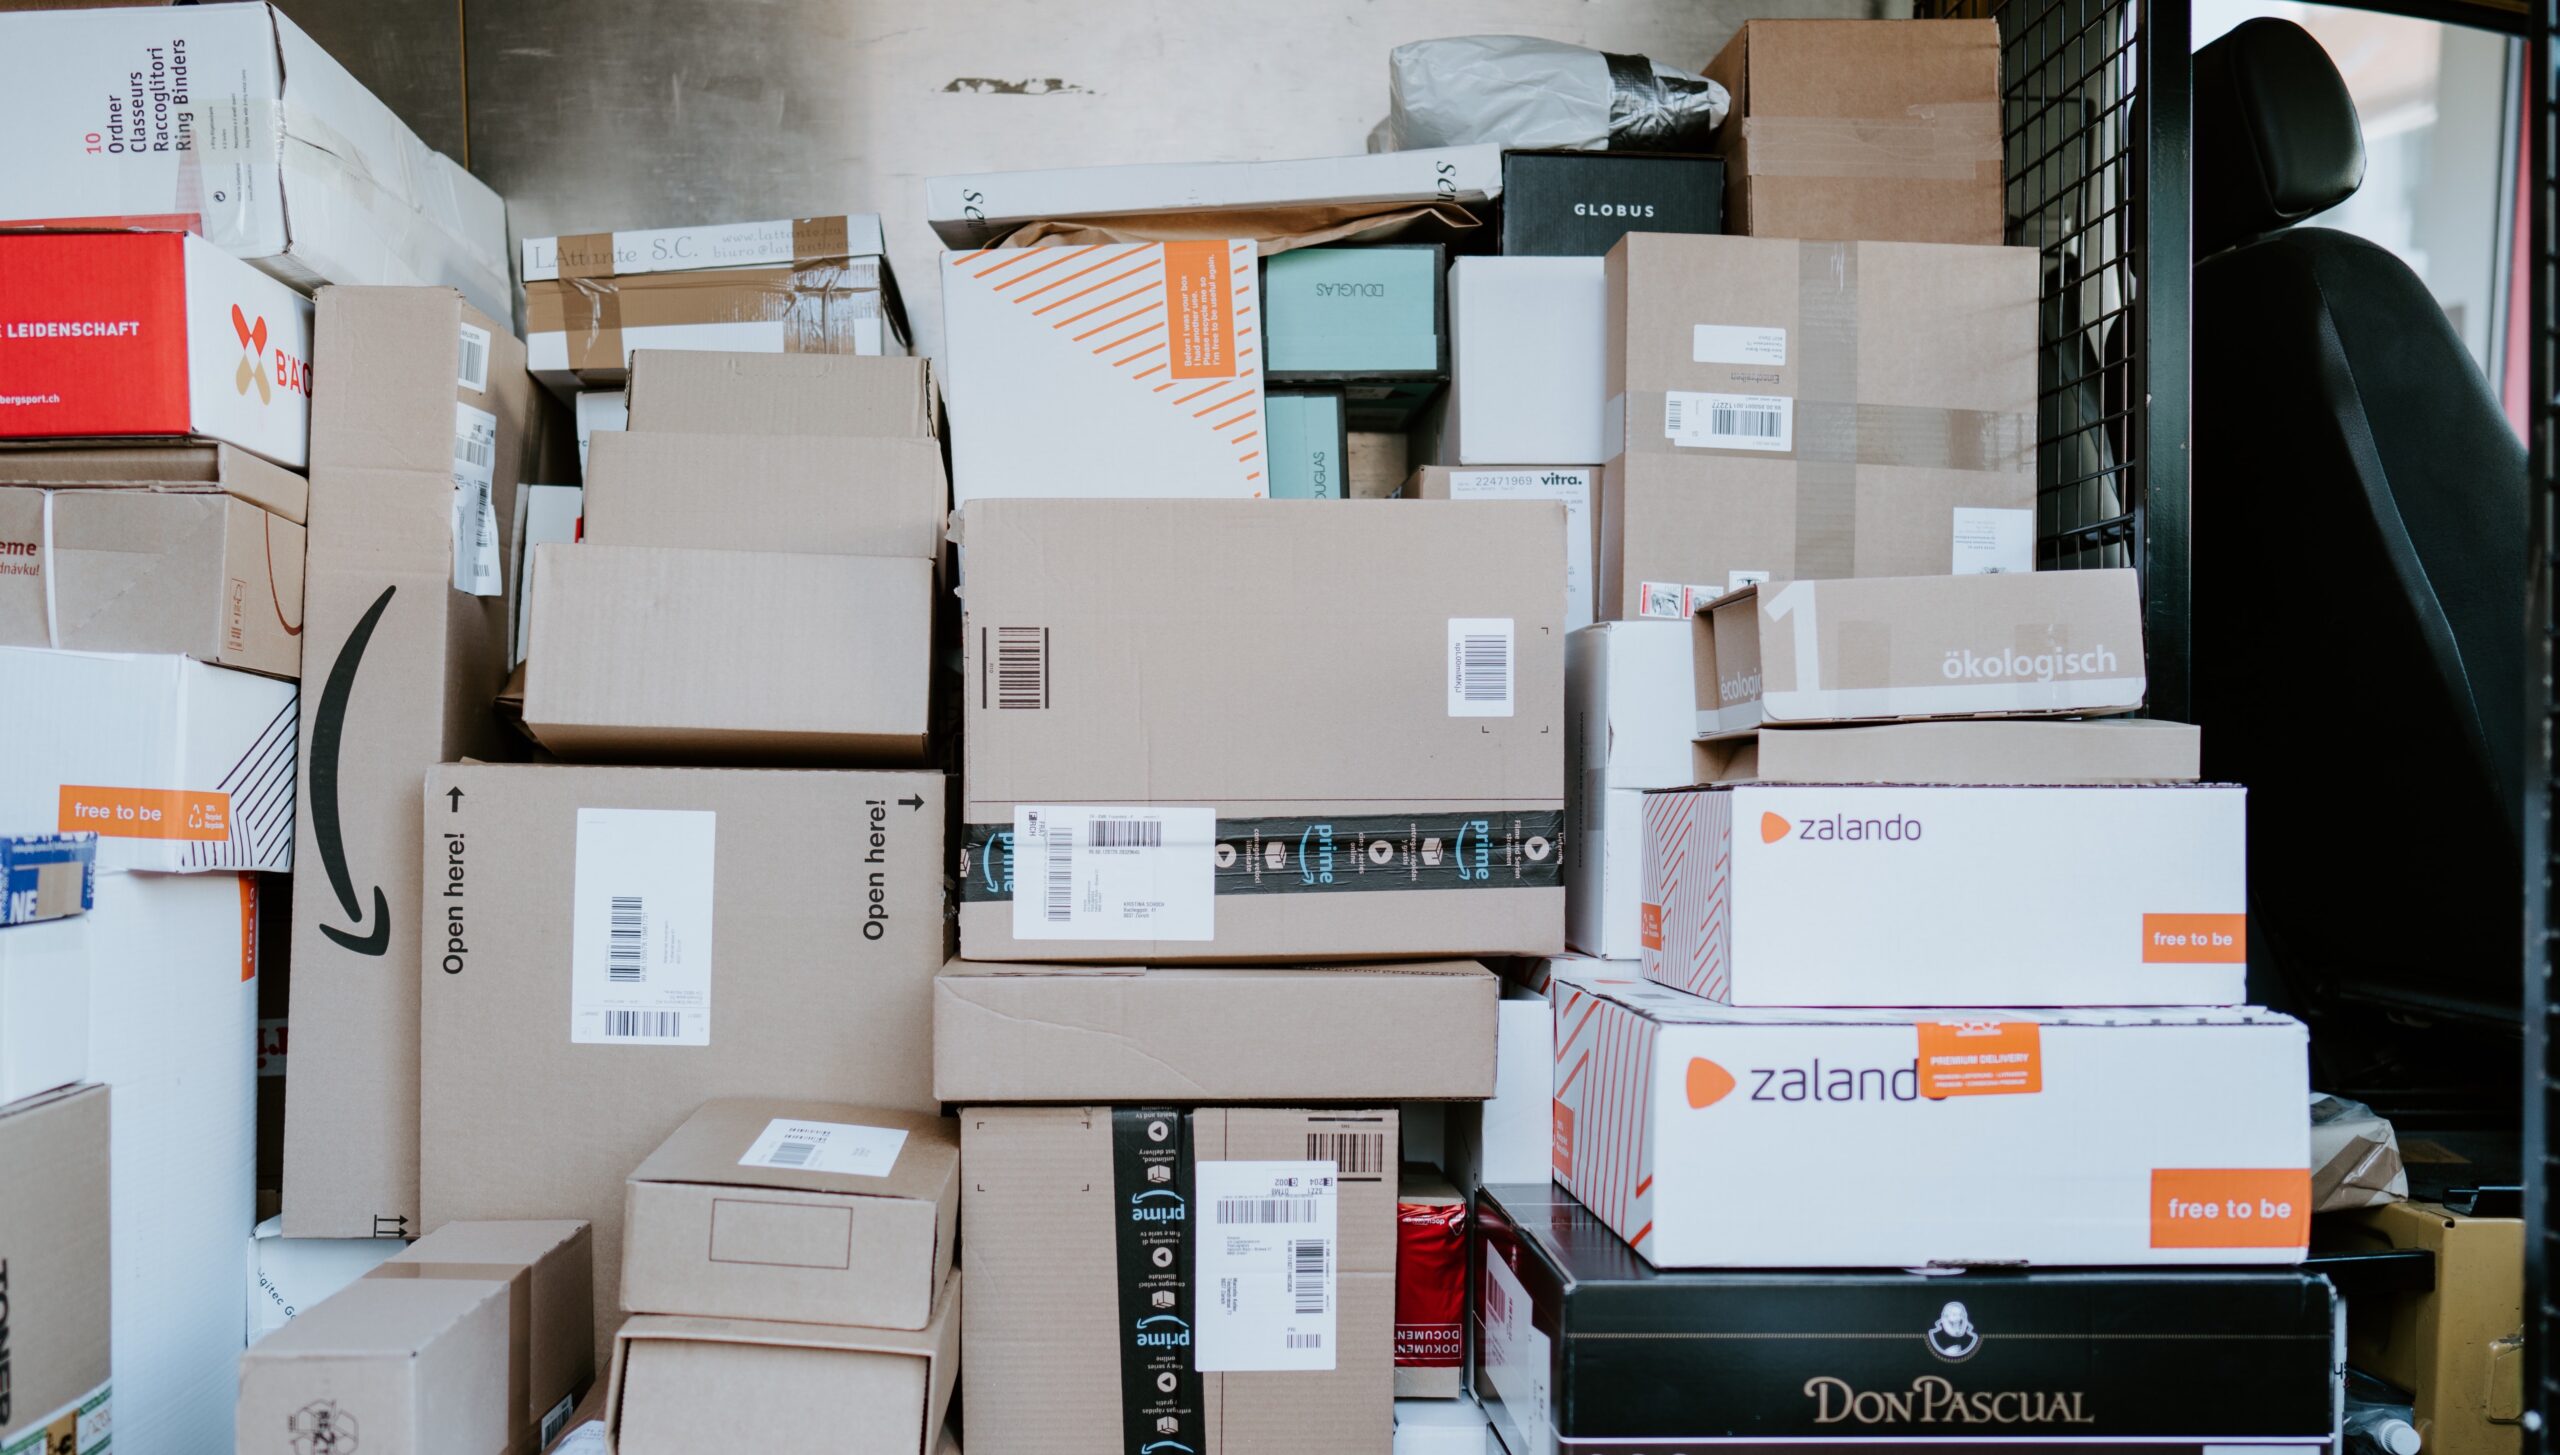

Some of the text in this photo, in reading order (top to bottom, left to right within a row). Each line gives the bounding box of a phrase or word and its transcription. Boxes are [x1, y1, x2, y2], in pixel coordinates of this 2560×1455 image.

[147, 47, 170, 152] Raccoglitori
[170, 39, 194, 151] Ring Binders
[107, 95, 124, 153] Ordner
[131, 71, 146, 153] Classeurs
[85, 132, 101, 154] 10
[1574, 203, 1655, 218] GLOBUS
[721, 225, 842, 244] www.lattante.eu
[535, 236, 698, 269] LAttante S.C.
[1180, 276, 1188, 291] box
[1316, 283, 1384, 297] DOUGLAS
[1181, 293, 1190, 312] your
[1207, 254, 1220, 365] I'm free to be useful again.
[7, 321, 140, 338] LEIDENSCHAFT
[1191, 311, 1200, 343] another
[1200, 277, 1210, 366] Please recycle me so
[1184, 339, 1192, 366] Before
[1193, 345, 1201, 361] had
[1475, 472, 1582, 486] 22471969 vitra.
[1764, 580, 2118, 693] 1 ökologisch
[74, 802, 162, 822] free to be
[1798, 813, 1922, 843] zalando
[1314, 824, 1338, 884] prime
[1470, 820, 1493, 880] prime
[863, 800, 889, 941] Open here!
[1410, 854, 1418, 881] rápidas
[443, 832, 468, 975] Open here!
[246, 887, 255, 964] free to
[2152, 930, 2233, 948] free to be
[1930, 1053, 2029, 1066] PREMIUM DELIVERY
[1750, 1058, 1946, 1103] zaland
[1132, 1204, 1185, 1224] prime
[2169, 1197, 2292, 1220] free to be
[1137, 1329, 1190, 1349] prime
[1394, 1330, 1460, 1340] DOCUMEN
[1394, 1344, 1459, 1354] DOKUMEN
[1156, 1399, 1173, 1407] gratis
[1912, 1375, 2096, 1425] PASCUAL
